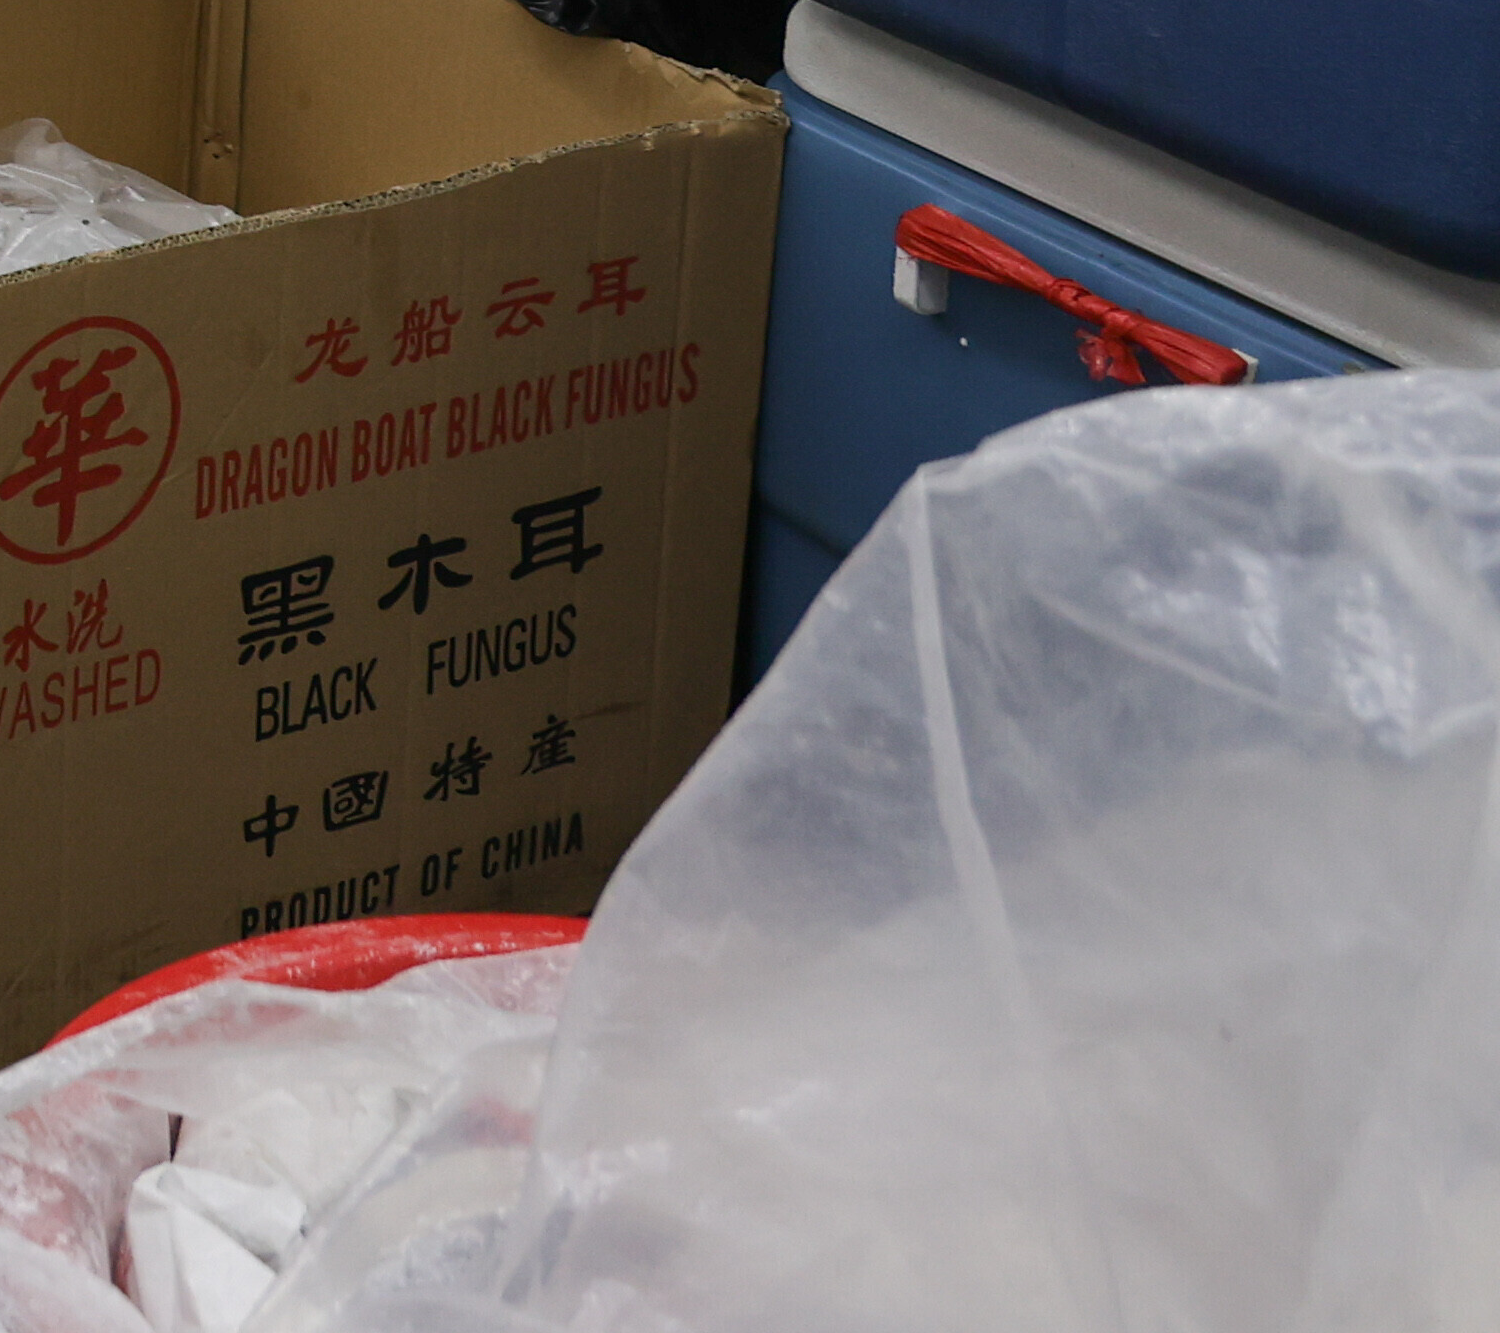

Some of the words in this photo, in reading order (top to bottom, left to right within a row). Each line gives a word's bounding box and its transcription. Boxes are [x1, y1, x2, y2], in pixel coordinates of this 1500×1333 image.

[295, 255, 647, 385] 龙船云耳
[195, 427, 338, 520] DRAGON
[350, 402, 439, 484] BOAT
[446, 375, 555, 454] BLACK
[564, 341, 701, 427] FUNGUS
[3, 577, 124, 671] 水洗
[237, 486, 605, 666] 黑木耳
[254, 657, 379, 742] BLACK
[426, 603, 578, 695] FUNGUS
[241, 863, 401, 940] PRODUCT
[419, 847, 463, 897] OF
[481, 812, 584, 880] CHINA
